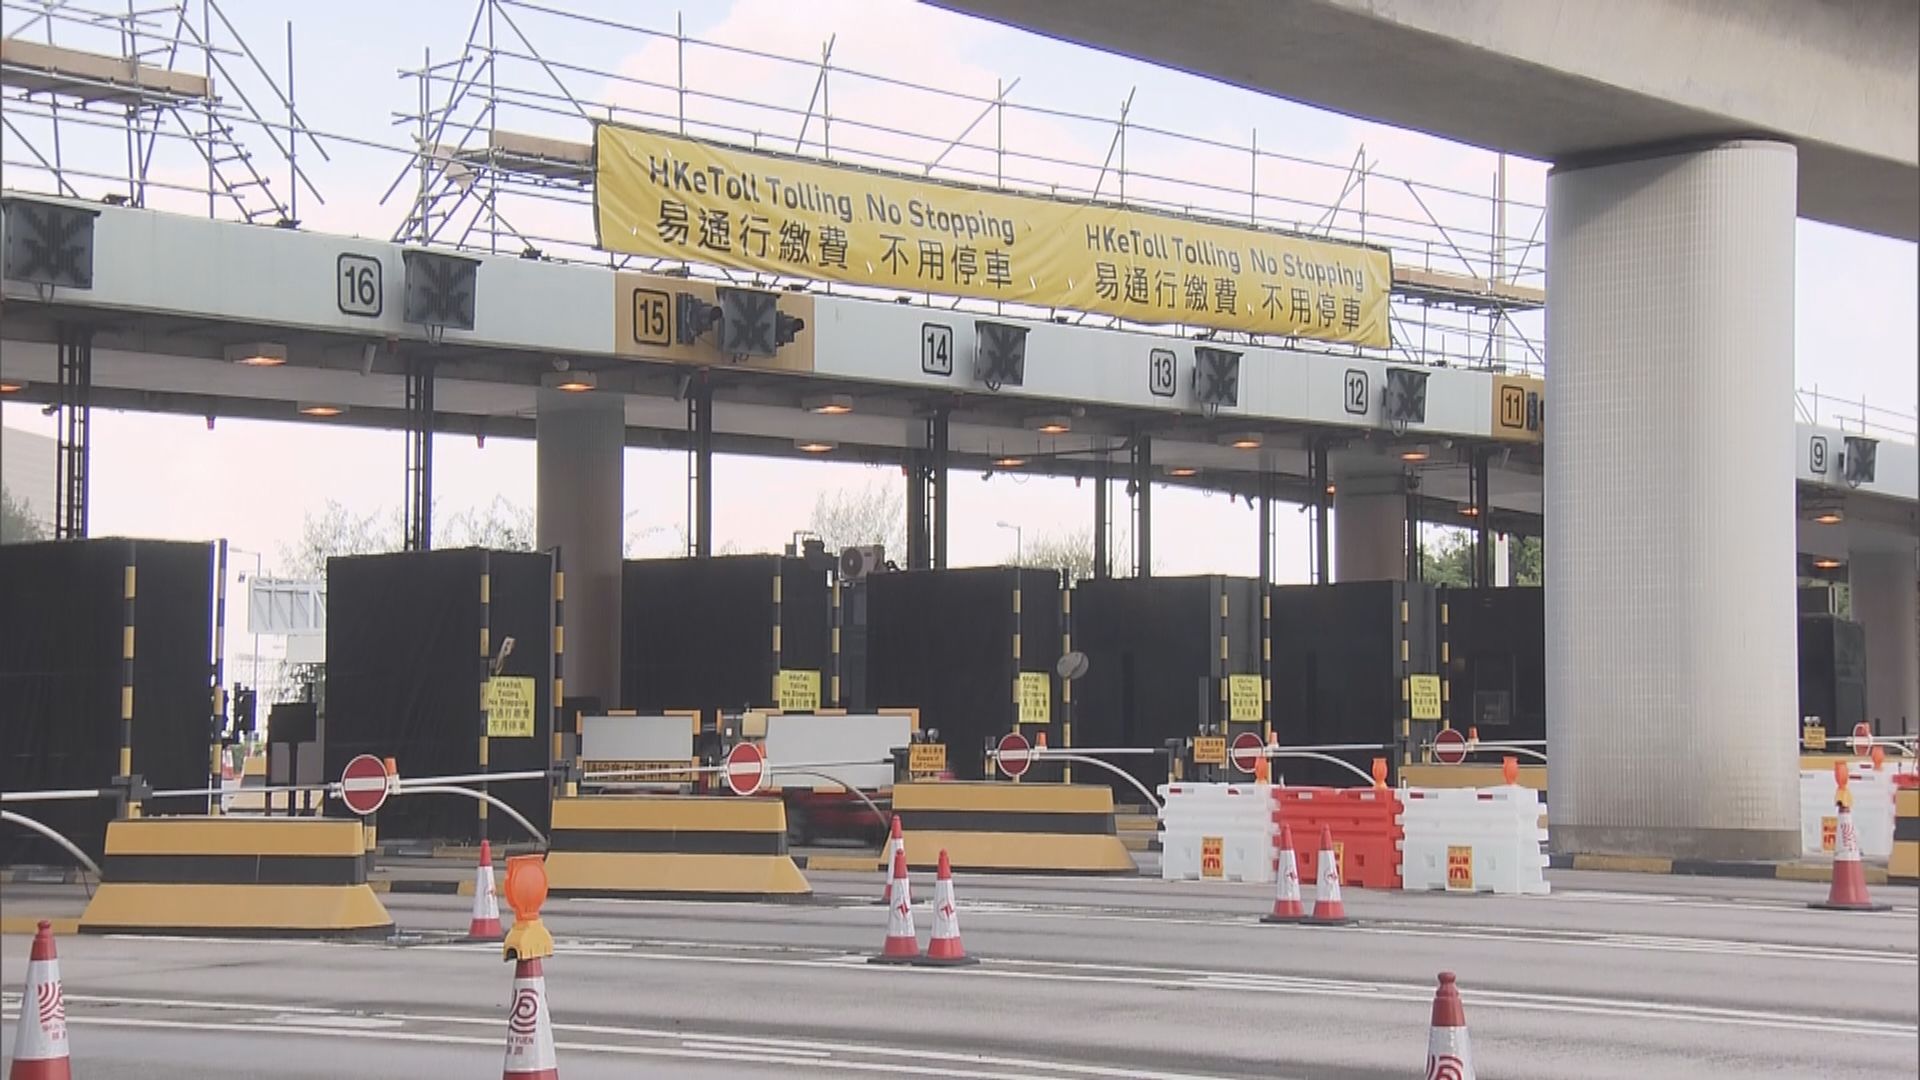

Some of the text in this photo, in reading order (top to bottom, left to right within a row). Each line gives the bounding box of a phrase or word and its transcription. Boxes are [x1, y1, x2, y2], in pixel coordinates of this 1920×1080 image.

[649, 156, 1015, 246] HKeToll Tolling No Stopping
[656, 200, 1013, 289] 易通行繳費 不用停車
[1085, 223, 1365, 292] HKeToll Tolling No Stopping
[345, 266, 375, 305] 16
[1095, 262, 1361, 332] 易通行繳費 不用停車
[640, 299, 664, 335] 15
[927, 333, 948, 365] 14
[1154, 357, 1171, 388] 13
[1348, 379, 1365, 407] 12
[1506, 393, 1520, 420] 11
[1814, 442, 1823, 466] 9
